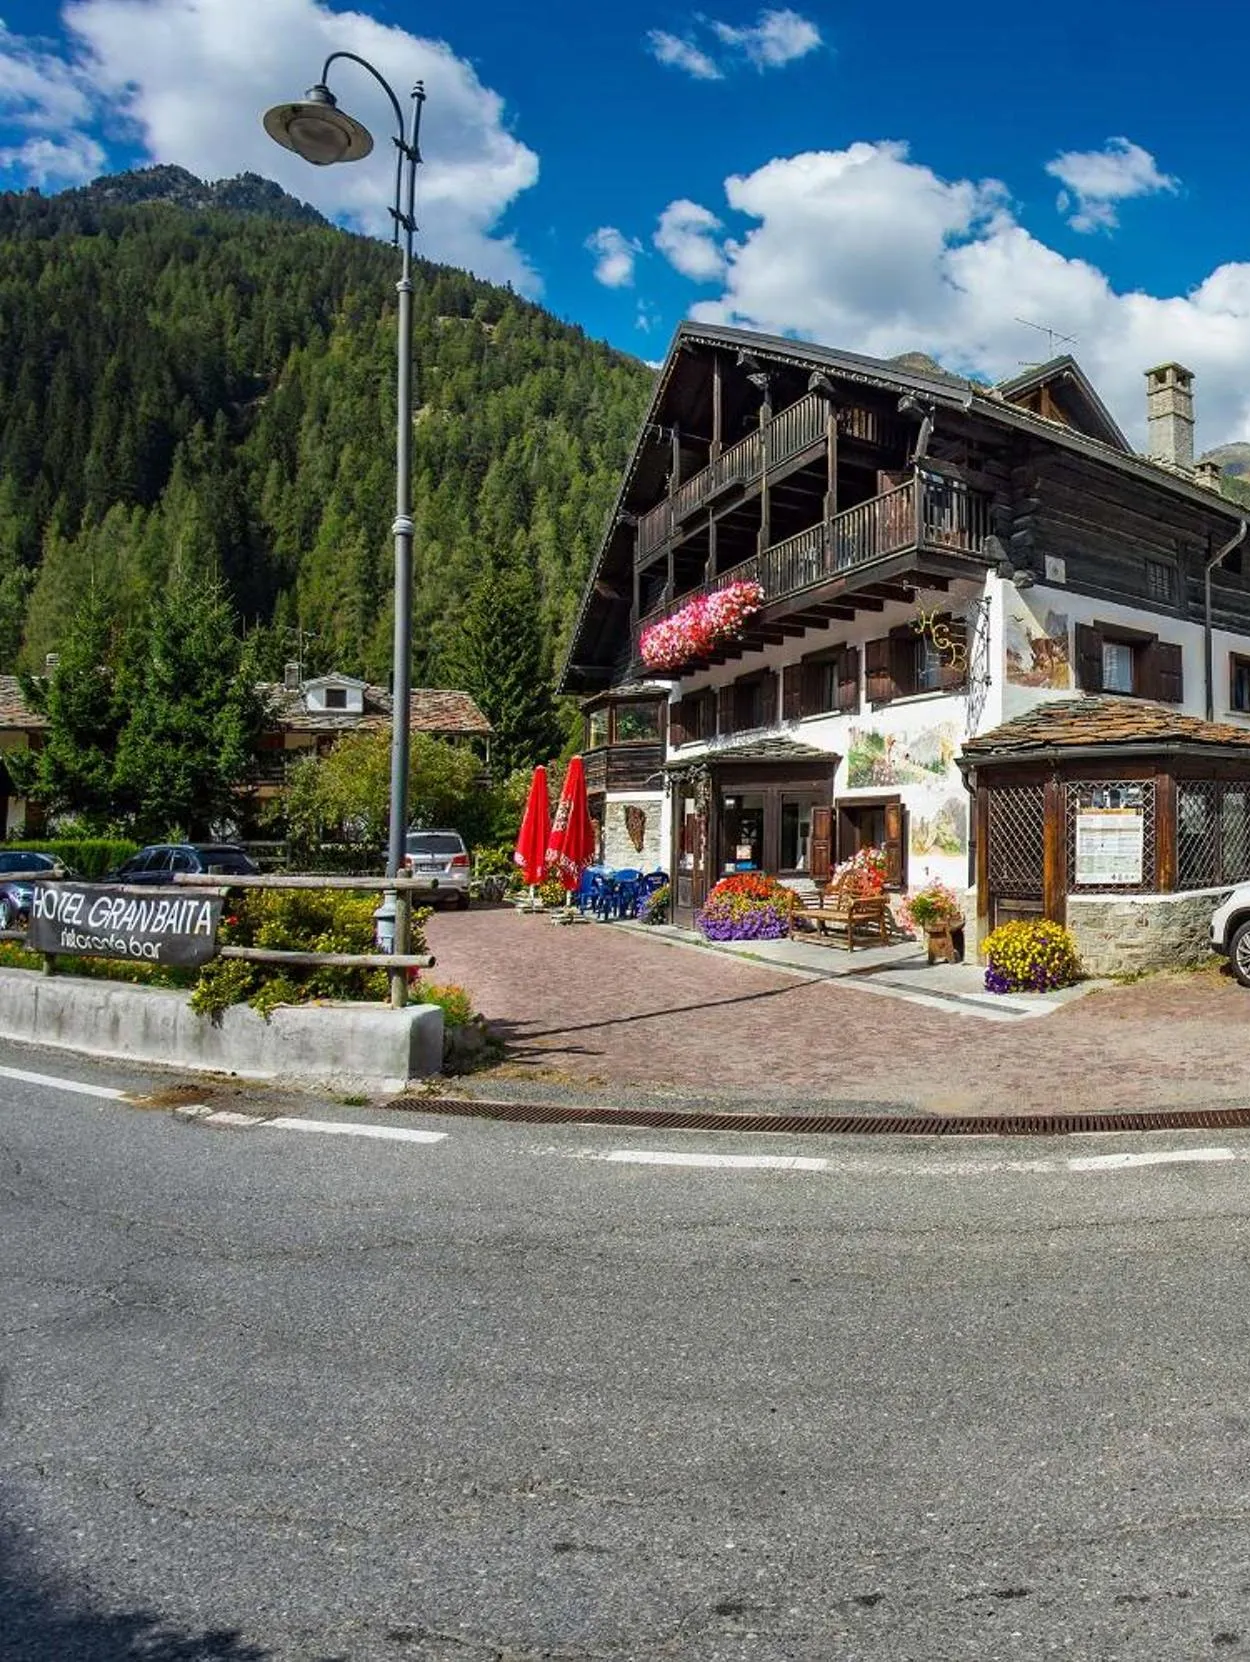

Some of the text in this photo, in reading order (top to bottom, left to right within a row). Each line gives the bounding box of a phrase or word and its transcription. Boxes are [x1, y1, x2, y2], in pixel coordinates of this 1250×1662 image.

[32, 886, 86, 926] HOTEL
[60, 928, 162, 960] ristorante bar
